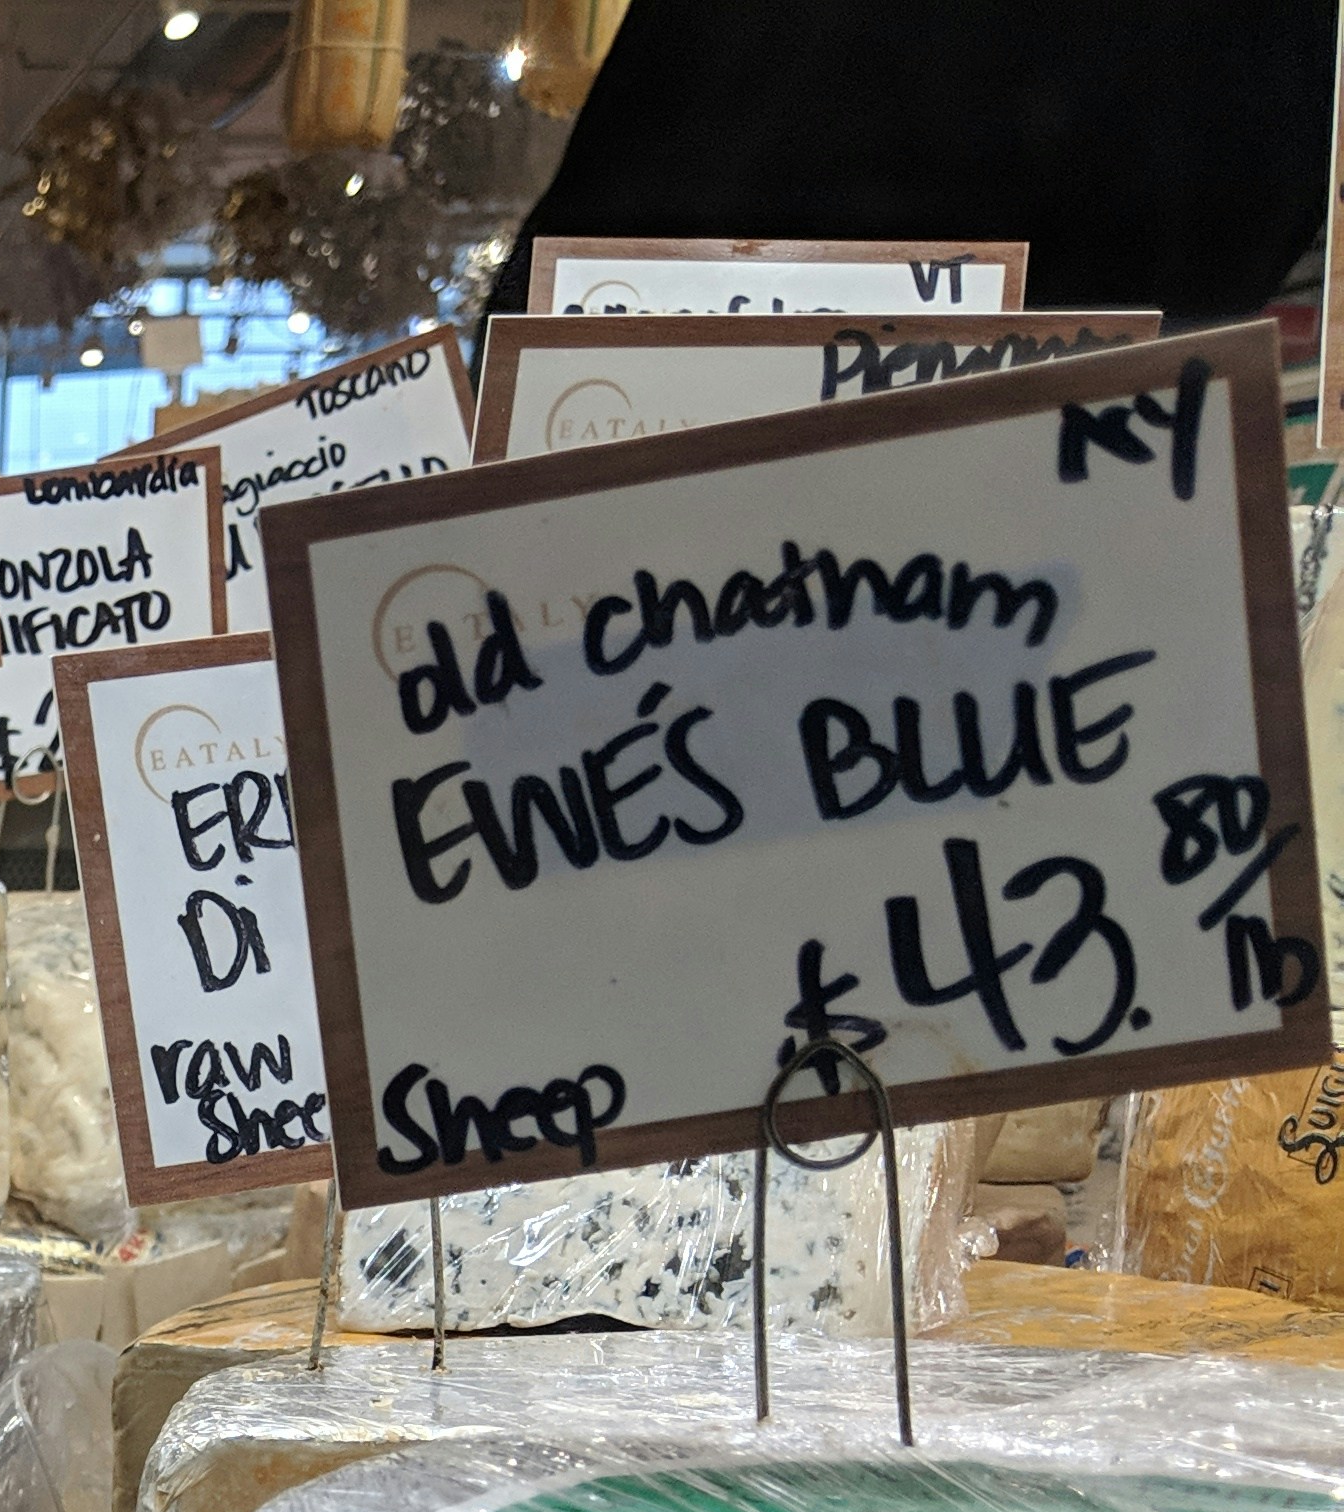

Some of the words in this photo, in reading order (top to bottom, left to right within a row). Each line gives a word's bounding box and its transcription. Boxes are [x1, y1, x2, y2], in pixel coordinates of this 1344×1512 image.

[908, 253, 977, 305] VT
[1057, 359, 1212, 500] NY
[0, 589, 173, 657] IFICATO
[799, 650, 1156, 821] BLUE
[150, 1032, 294, 1104] raw
